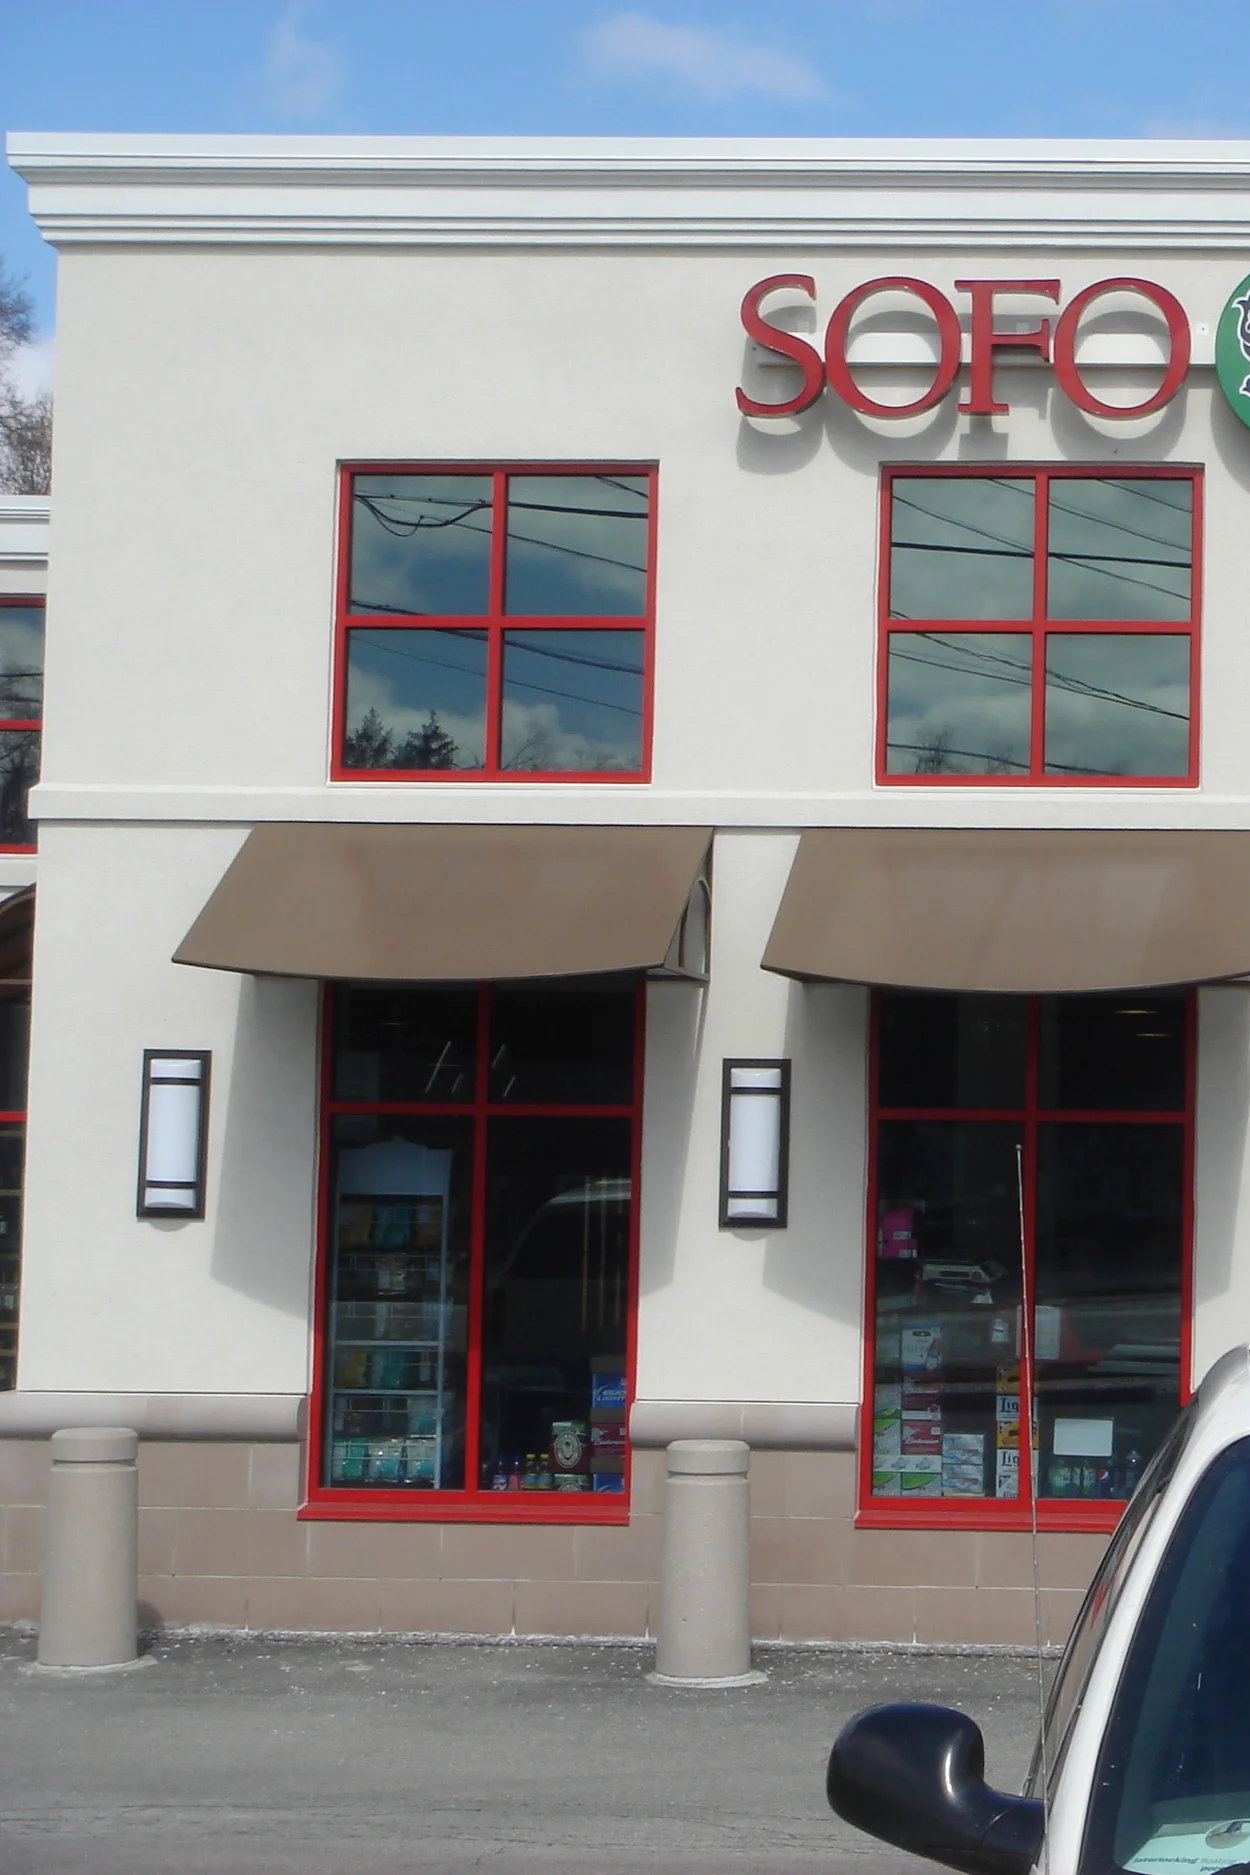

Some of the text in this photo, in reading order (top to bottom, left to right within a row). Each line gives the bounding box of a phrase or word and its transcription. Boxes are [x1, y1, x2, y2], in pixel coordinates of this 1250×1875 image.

[735, 273, 1192, 419] SOFO
[1000, 1396, 1020, 1413] Lig
[1001, 1450, 1020, 1468] Lig
